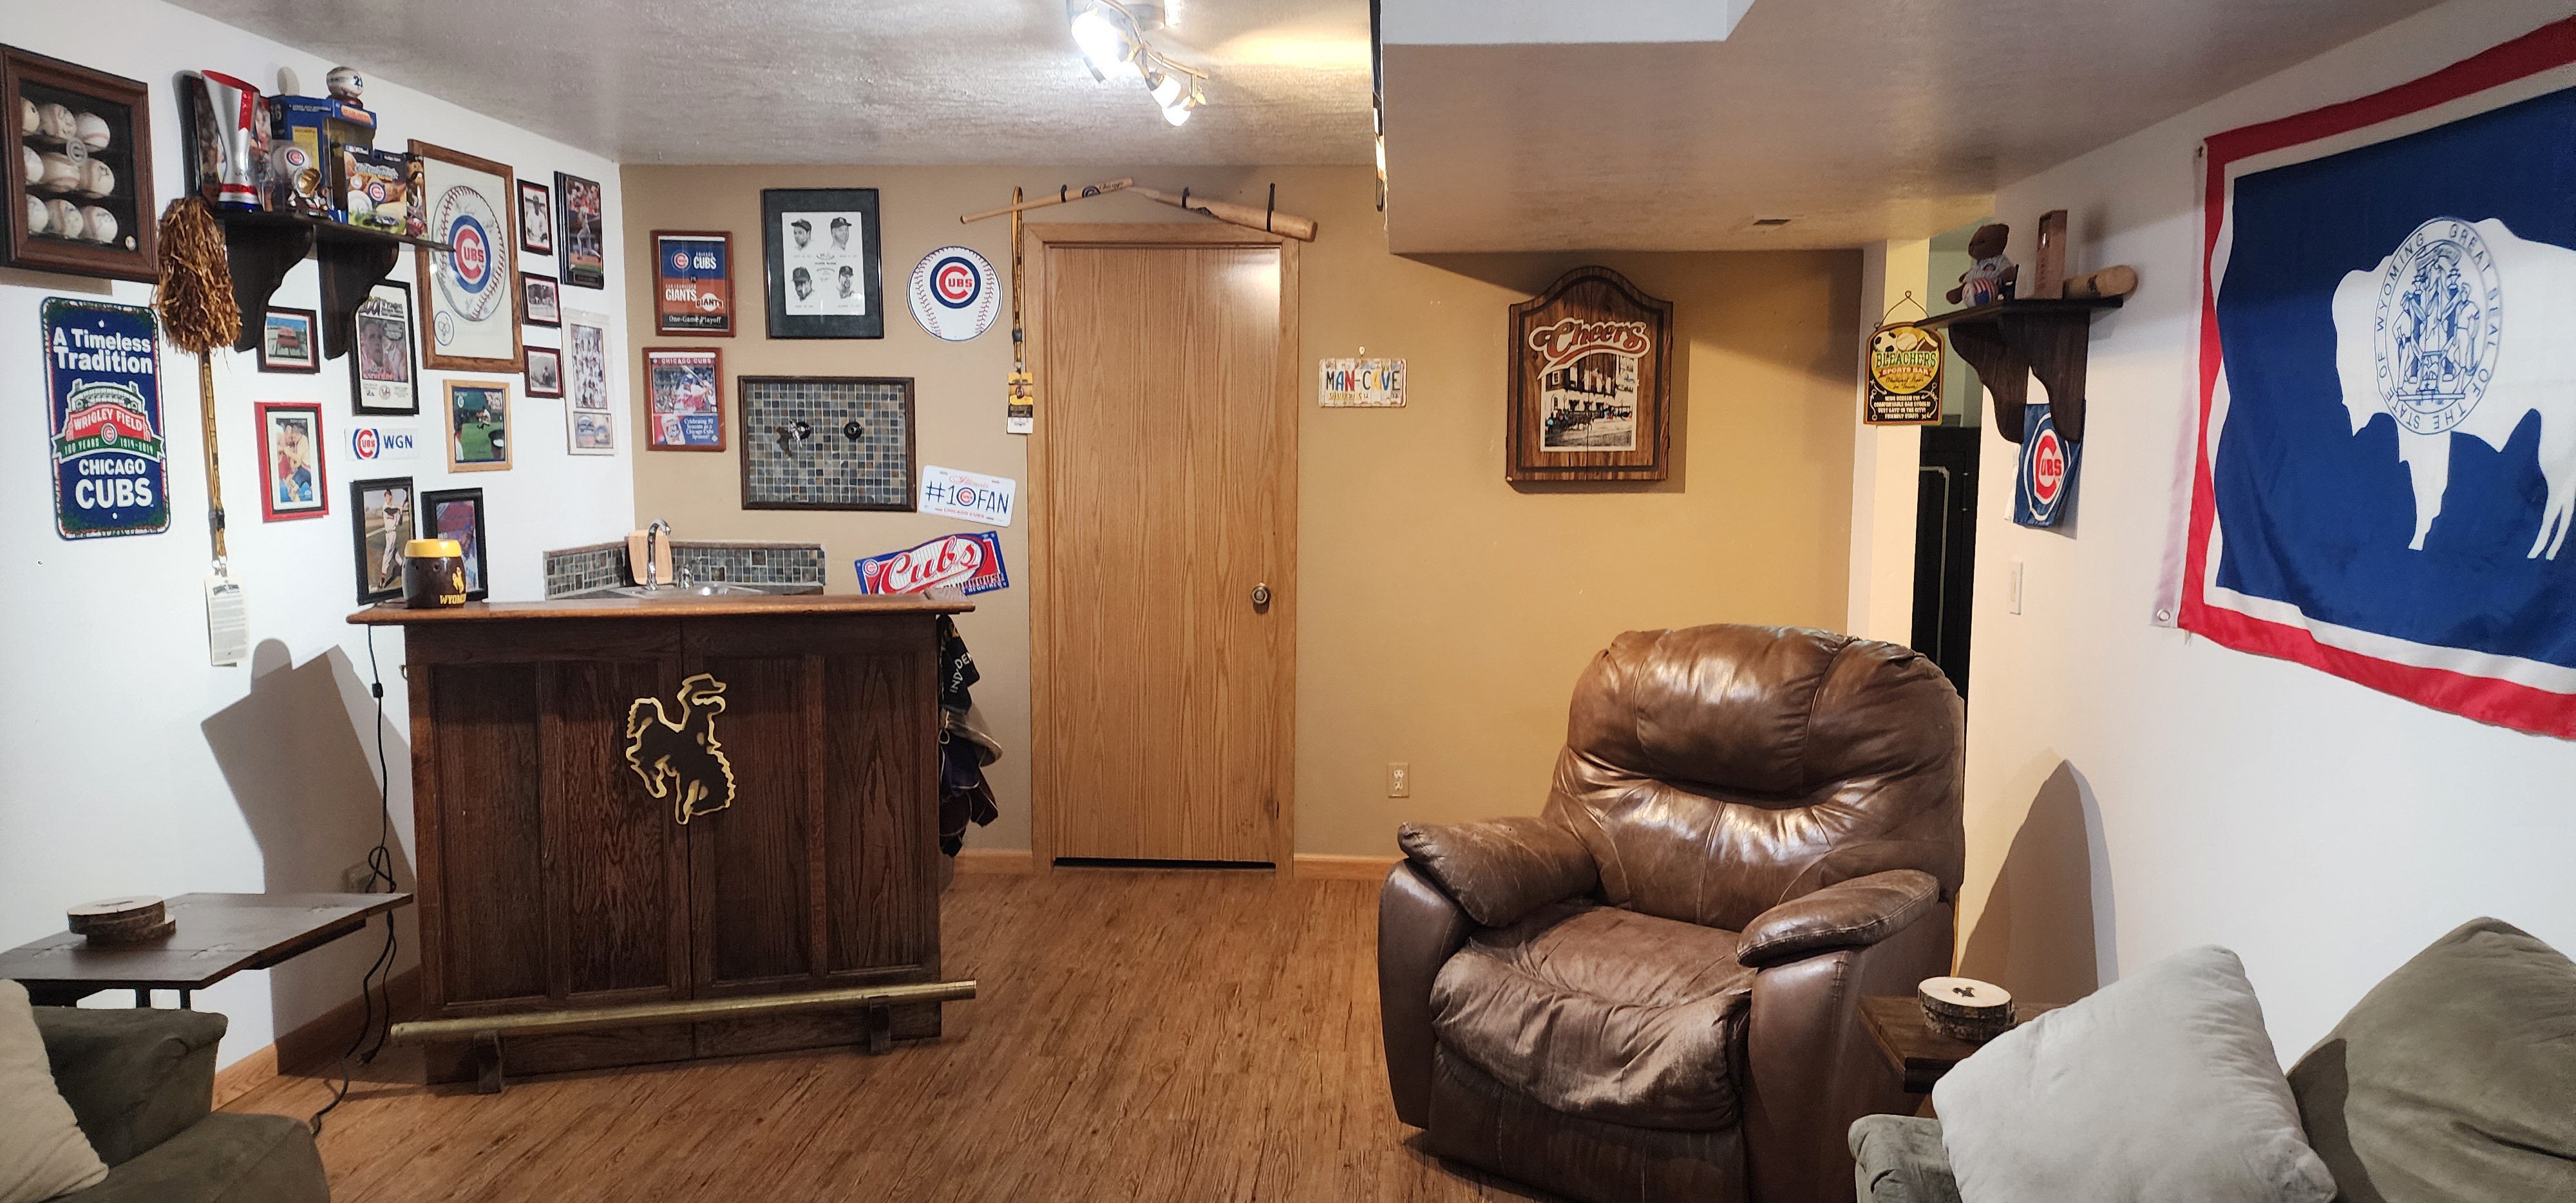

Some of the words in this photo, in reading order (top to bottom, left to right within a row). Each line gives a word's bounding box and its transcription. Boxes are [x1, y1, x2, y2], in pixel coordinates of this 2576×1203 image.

[455, 229, 484, 279] CUBS
[2449, 223, 2491, 273] GREAT
[694, 256, 717, 270] CUBS
[666, 288, 697, 301] GIANTS
[939, 266, 972, 299] CUBS
[2376, 232, 2425, 332] WYOMING
[696, 298, 722, 308] GIANTS
[701, 316, 721, 325] Playoff
[53, 327, 68, 346] A
[71, 328, 151, 353] Timeless
[1530, 318, 1650, 366] Cheers
[53, 346, 153, 374] Tradition
[1876, 352, 1937, 368] BLEACHERS
[2378, 352, 2387, 379] OF
[1326, 370, 1400, 392] MAN-CAVE
[2472, 368, 2488, 397] OF
[73, 408, 113, 431] WRIGLEY
[116, 410, 142, 431] FIELD
[2384, 387, 2421, 430] STATE
[2433, 403, 2467, 430] THE
[383, 435, 413, 450] WGN
[79, 459, 146, 476] CHICAGO
[2036, 435, 2062, 499] CUBS
[75, 477, 153, 509] CUBS
[925, 480, 956, 506] #1
[977, 489, 1009, 514] FAN
[881, 536, 980, 593] Cubs
